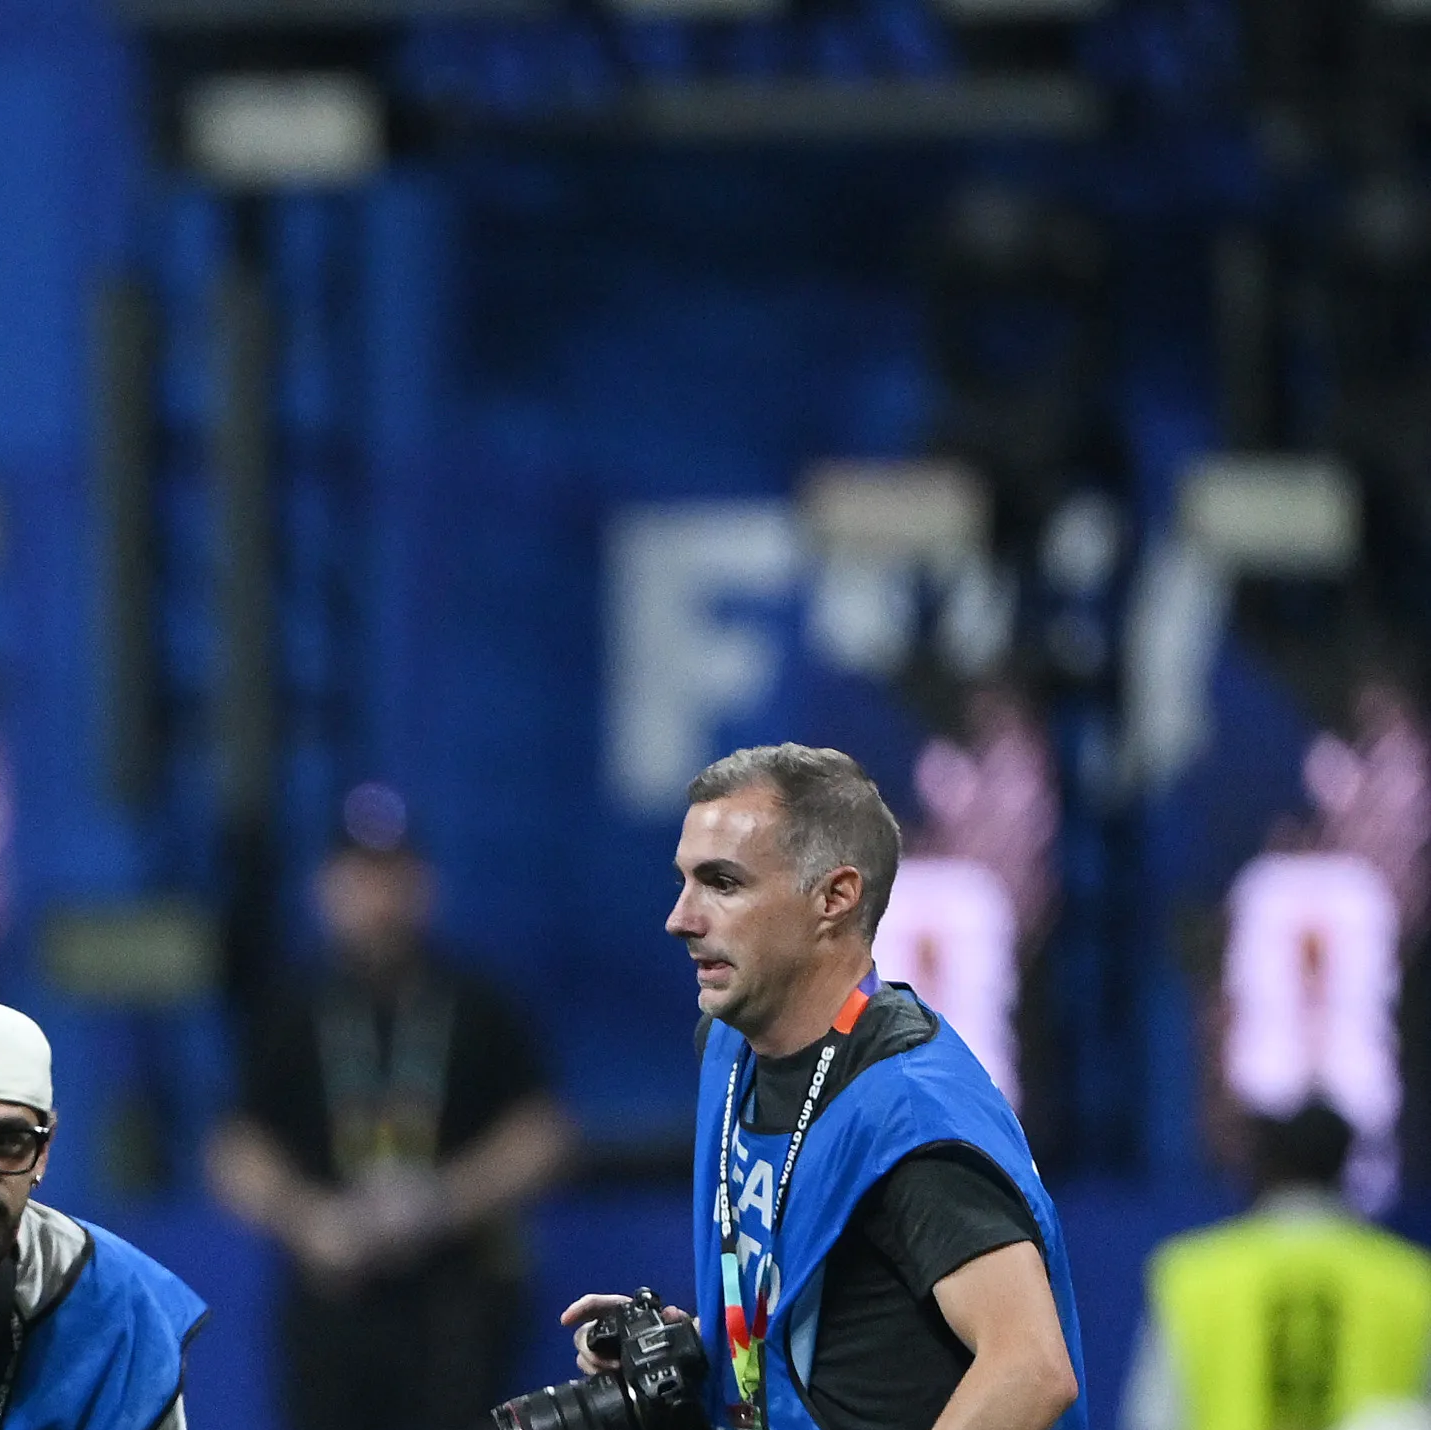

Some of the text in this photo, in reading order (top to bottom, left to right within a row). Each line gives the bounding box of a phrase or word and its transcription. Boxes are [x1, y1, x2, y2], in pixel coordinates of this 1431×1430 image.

[779, 1130, 804, 1186] WORLD
[797, 1099, 815, 1131] CUP
[808, 1045, 836, 1100] 2026
